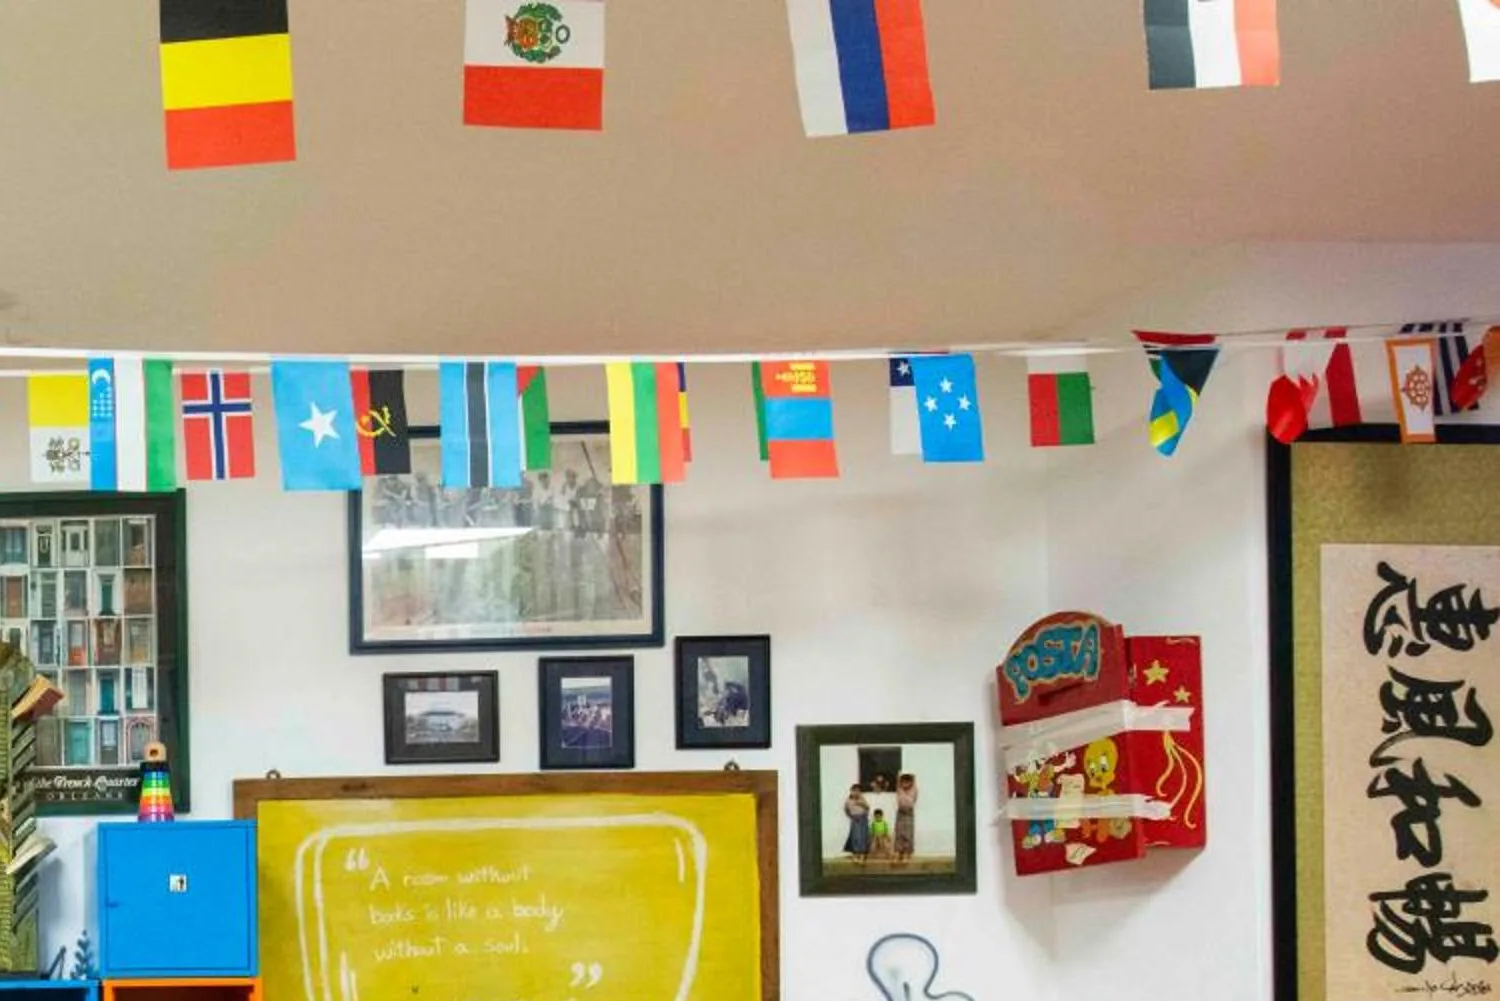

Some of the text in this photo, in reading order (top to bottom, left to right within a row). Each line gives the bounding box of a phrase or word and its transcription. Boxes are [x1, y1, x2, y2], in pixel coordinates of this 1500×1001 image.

[1003, 623, 1099, 703] POSTA
[458, 865, 531, 885] without
[447, 898, 477, 921] like
[486, 907, 503, 920] a
[375, 936, 448, 962] without
[455, 942, 469, 954] a
